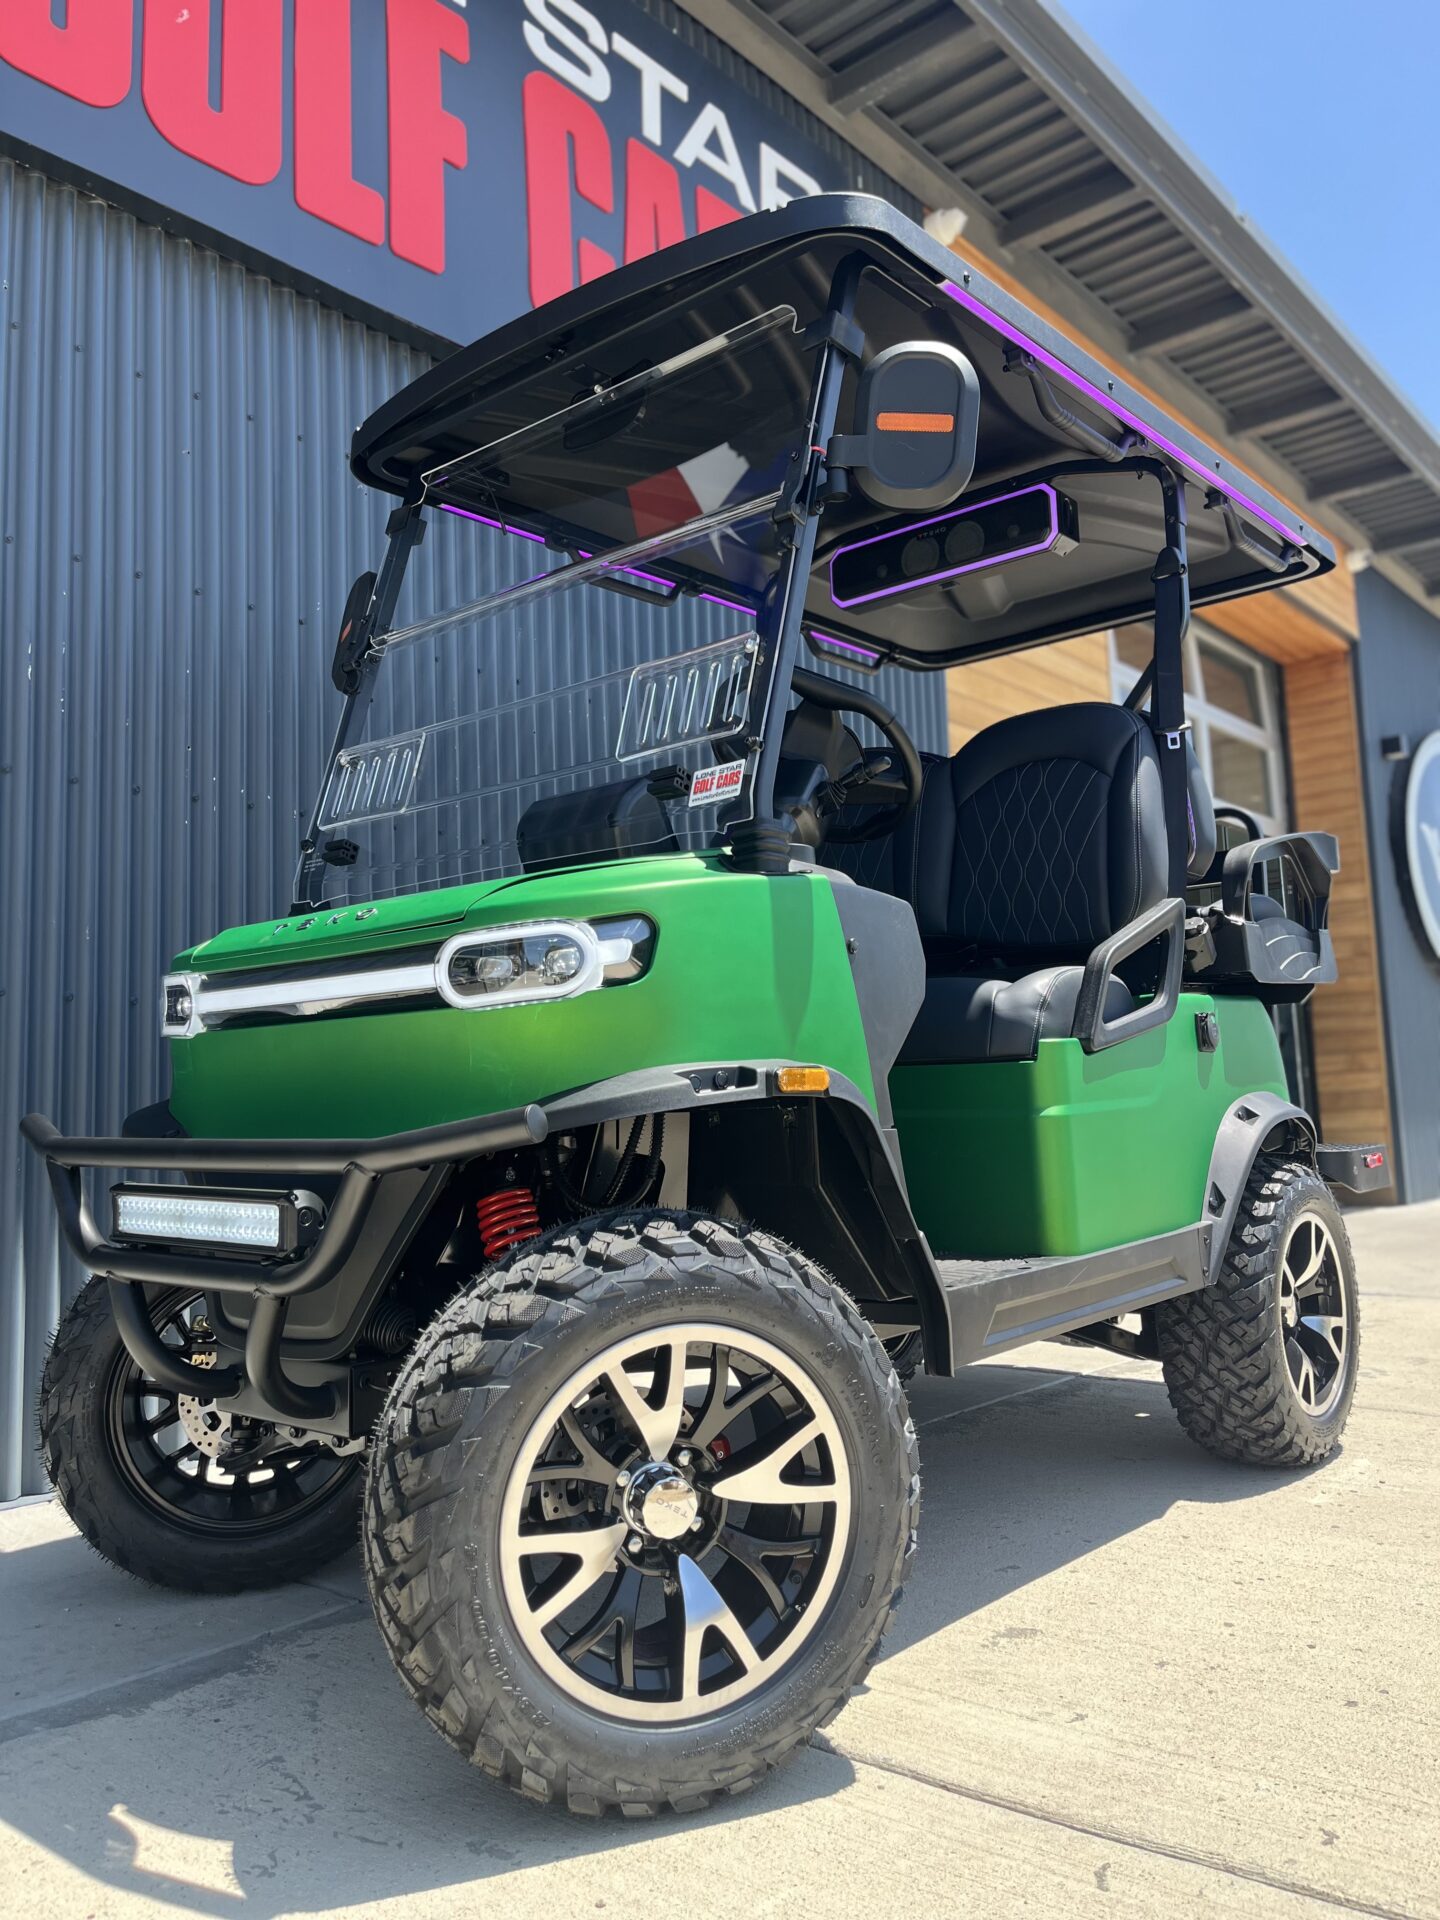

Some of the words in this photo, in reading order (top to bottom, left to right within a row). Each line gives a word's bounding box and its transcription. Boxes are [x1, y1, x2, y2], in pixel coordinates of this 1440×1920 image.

[693, 776, 715, 795] GOLF
[715, 769, 742, 789] CARS
[695, 770, 716, 780] LONE
[718, 763, 742, 775] STAR
[272, 907, 378, 936] TEKO
[655, 1497, 688, 1519] TEKO
